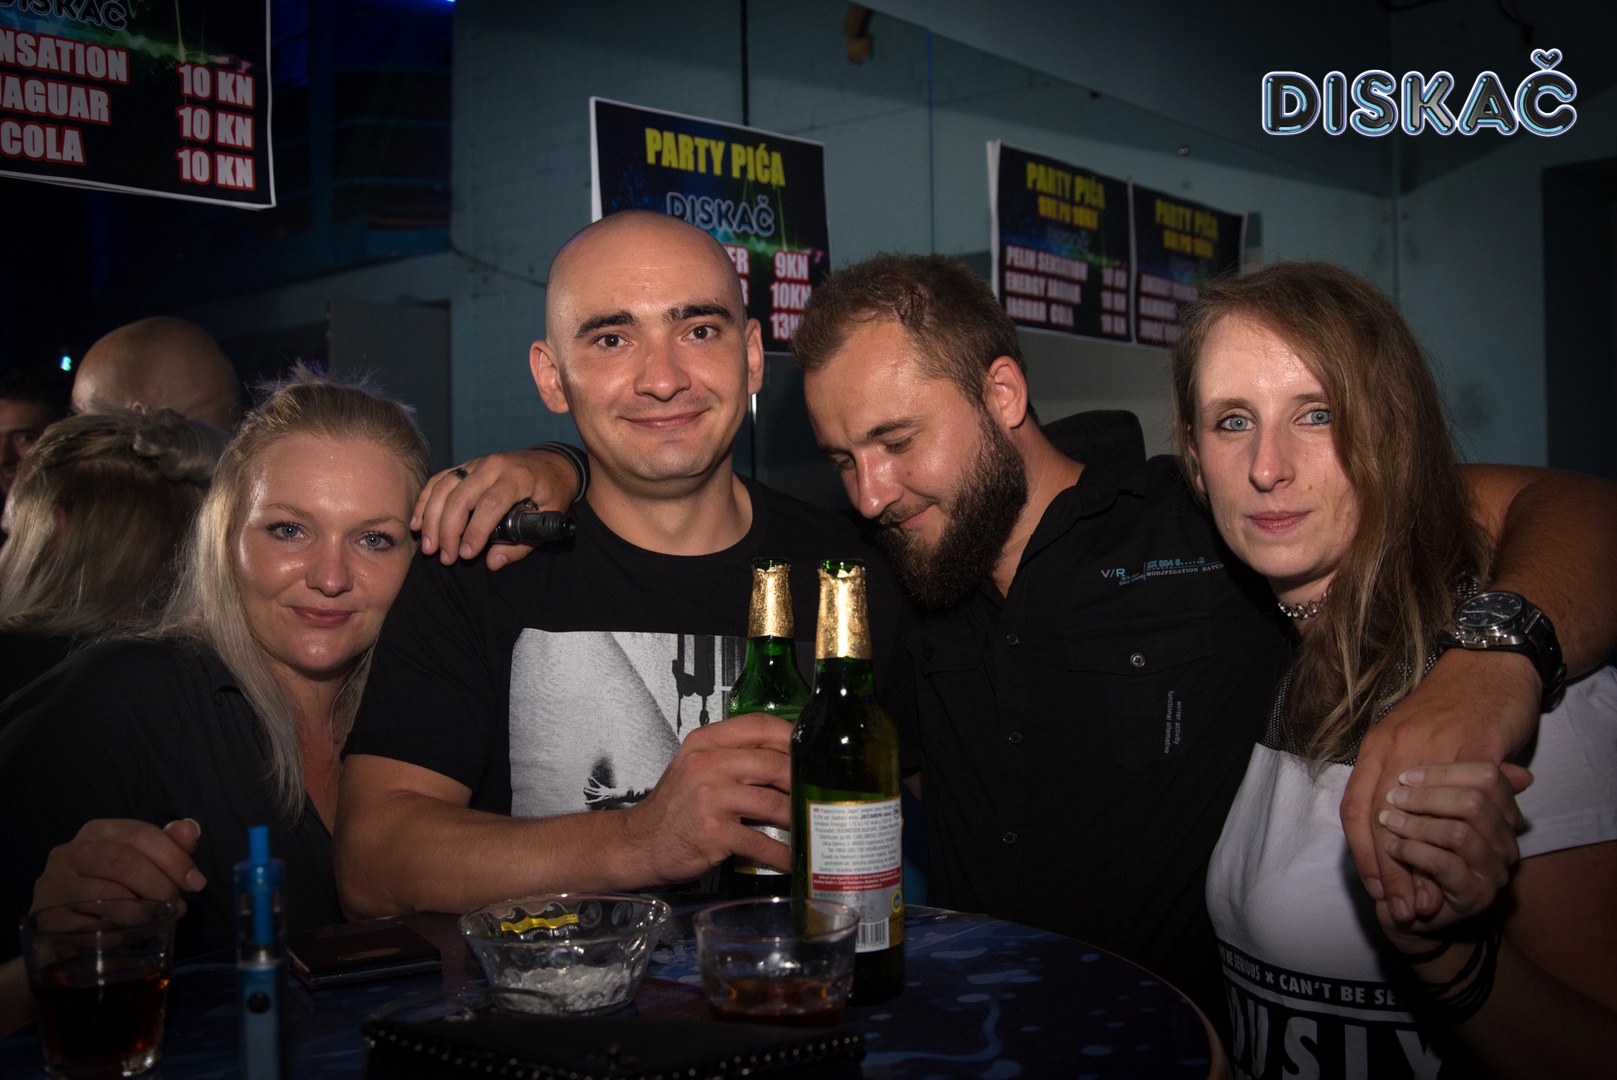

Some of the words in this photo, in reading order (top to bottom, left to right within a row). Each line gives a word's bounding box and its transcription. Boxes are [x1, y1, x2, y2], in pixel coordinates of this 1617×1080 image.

[176, 62, 213, 101] 10
[215, 68, 255, 109] KN
[0, 120, 86, 165] COLA
[176, 104, 212, 143] 10
[215, 110, 254, 150] KN
[176, 147, 212, 185] 10
[215, 152, 255, 190] KN
[645, 128, 726, 175] PARTY
[731, 143, 786, 186] PIĆA
[1026, 161, 1072, 199] PARTY
[775, 251, 809, 281] 9KN
[1166, 690, 1175, 720] functional
[1173, 722, 1182, 745] activity
[1279, 974, 1333, 999] CAN'T
[1340, 985, 1365, 1003] BE
